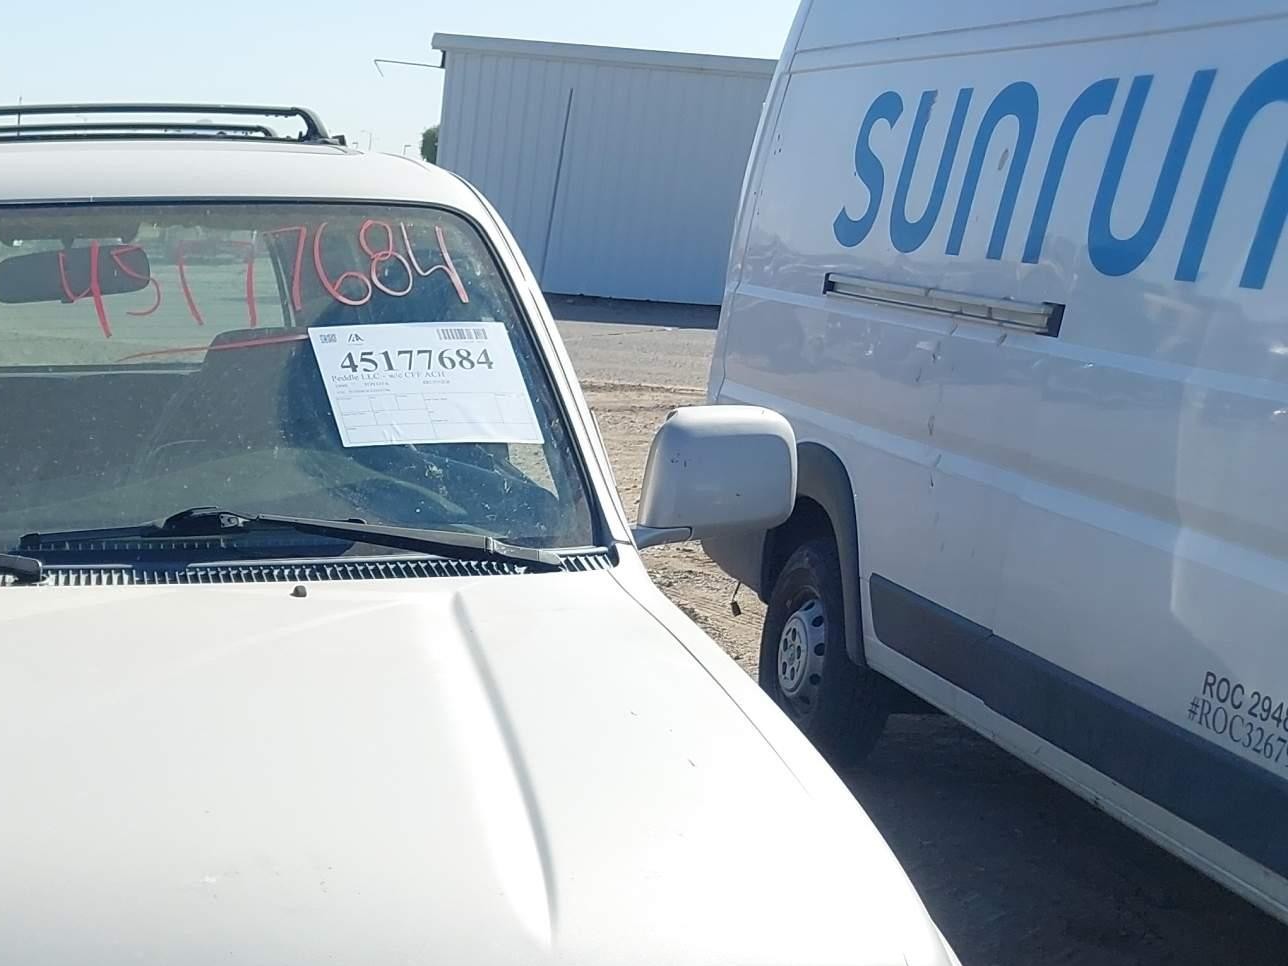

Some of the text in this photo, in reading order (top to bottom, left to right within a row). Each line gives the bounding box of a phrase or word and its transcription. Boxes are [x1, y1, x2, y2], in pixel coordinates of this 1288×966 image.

[833, 58, 1288, 290] sunrun
[340, 348, 494, 373] 45177684
[1202, 671, 1245, 710] ROC
[1188, 696, 1288, 763] #ROC3267
